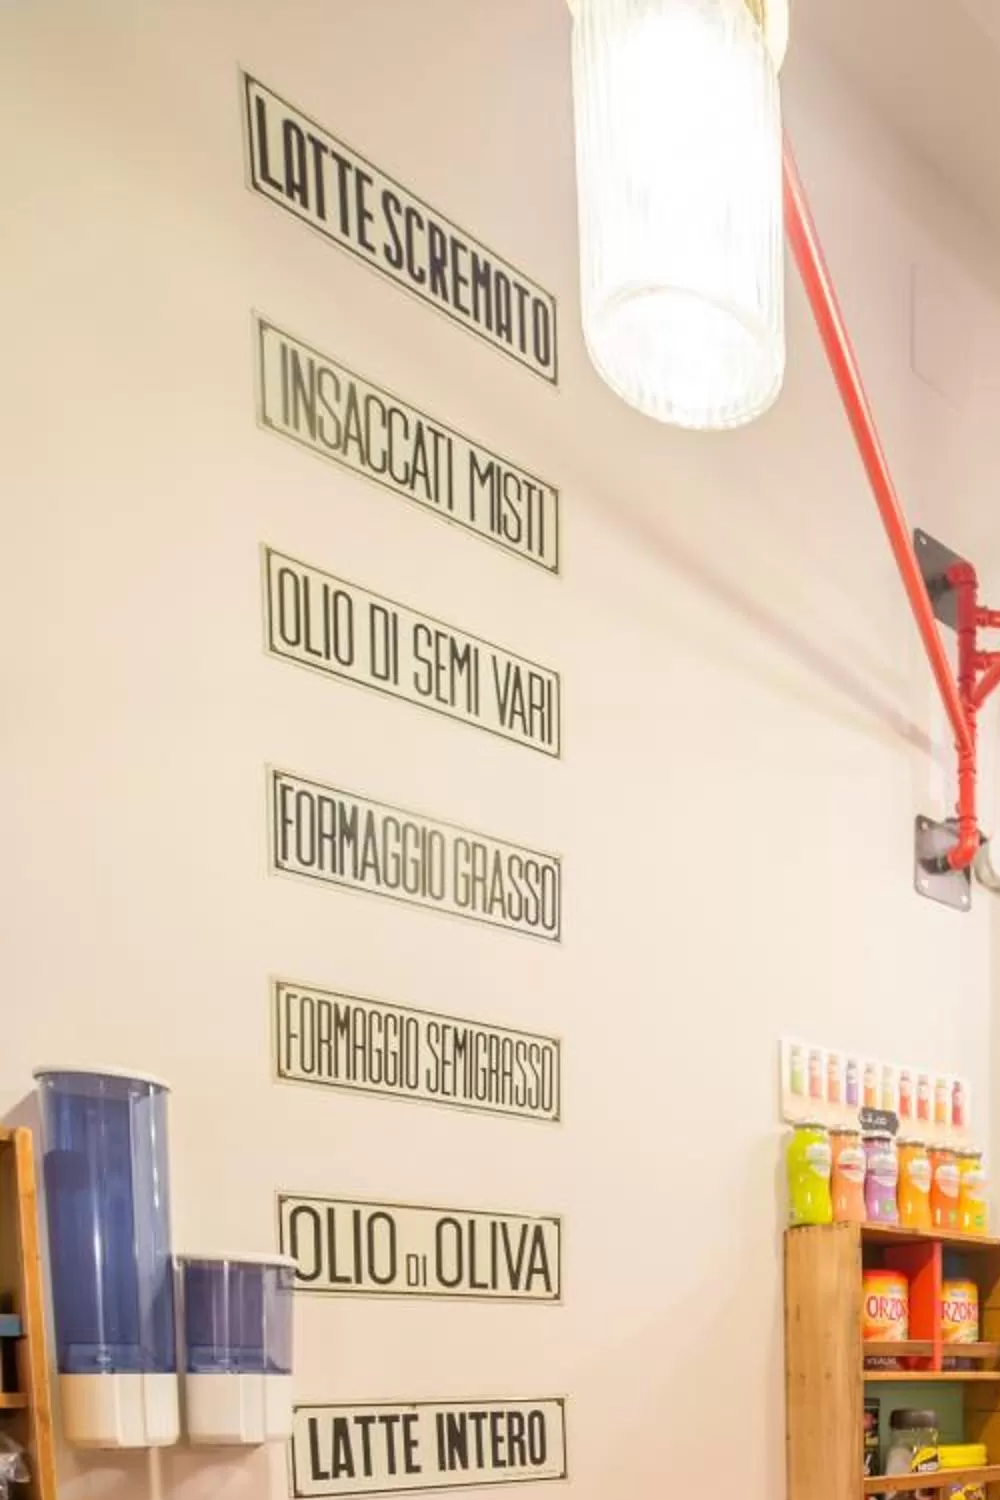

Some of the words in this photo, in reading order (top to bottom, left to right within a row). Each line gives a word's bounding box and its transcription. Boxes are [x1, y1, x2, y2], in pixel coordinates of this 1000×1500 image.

[254, 95, 375, 254] LATTE
[380, 188, 551, 367] SCREMATO
[280, 341, 455, 511] INSACCATI
[468, 449, 546, 558] MISTI
[277, 567, 354, 668] OLIO
[369, 603, 399, 686] DI
[413, 624, 480, 717] SEMI
[491, 654, 553, 745] VARI
[280, 785, 446, 902] FORMAGGIO
[452, 838, 557, 931] GRASSO
[285, 993, 420, 1090] FORMAGGIO
[425, 1022, 554, 1113] SEMIGRASSO
[290, 1205, 397, 1285] OLIO
[406, 1254, 427, 1287] DI
[435, 1218, 552, 1293] OLIVA
[308, 1414, 422, 1481] LATTE
[436, 1409, 547, 1470] INTERO
